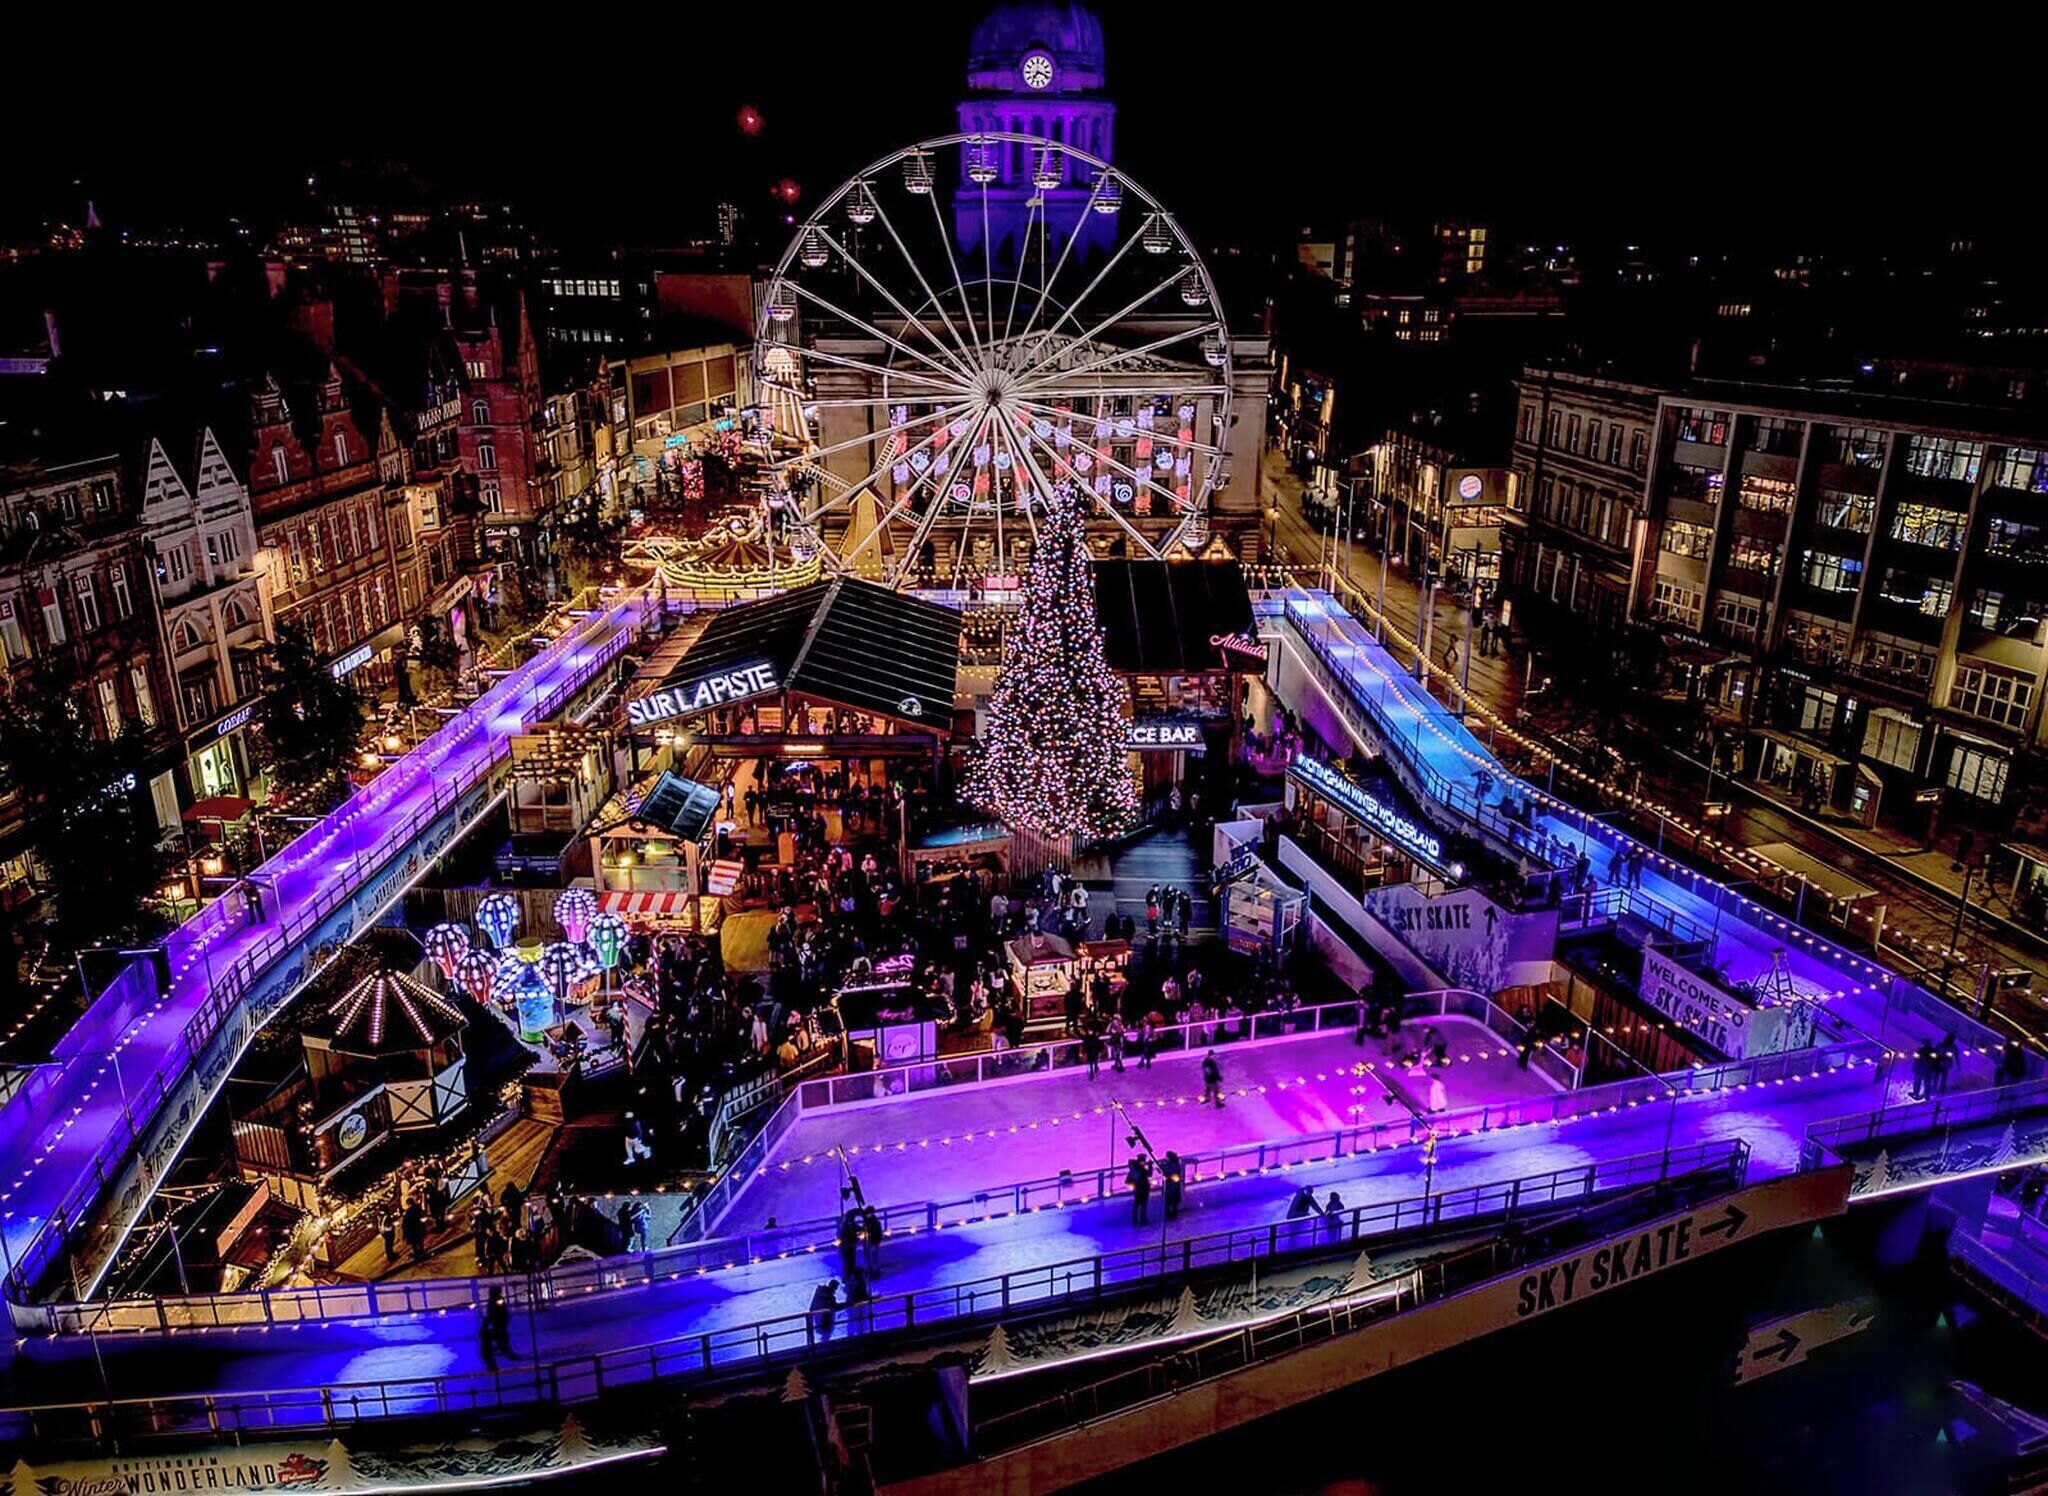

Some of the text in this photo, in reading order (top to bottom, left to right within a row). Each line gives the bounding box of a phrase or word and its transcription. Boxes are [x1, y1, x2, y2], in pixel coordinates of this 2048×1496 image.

[627, 693, 678, 725] SUR
[1160, 727, 1196, 743] BAR
[1351, 786, 1379, 817] WINTER
[1379, 804, 1440, 858] WONDERLAND
[1399, 903, 1471, 931] SKY SKATE
[1649, 960, 1745, 1028] WELCOME TO
[1655, 987, 1682, 1018] SKY
[1517, 1217, 1693, 1316] SKY SKATE
[56, 1463, 277, 1496] Winter WONDERLAND
